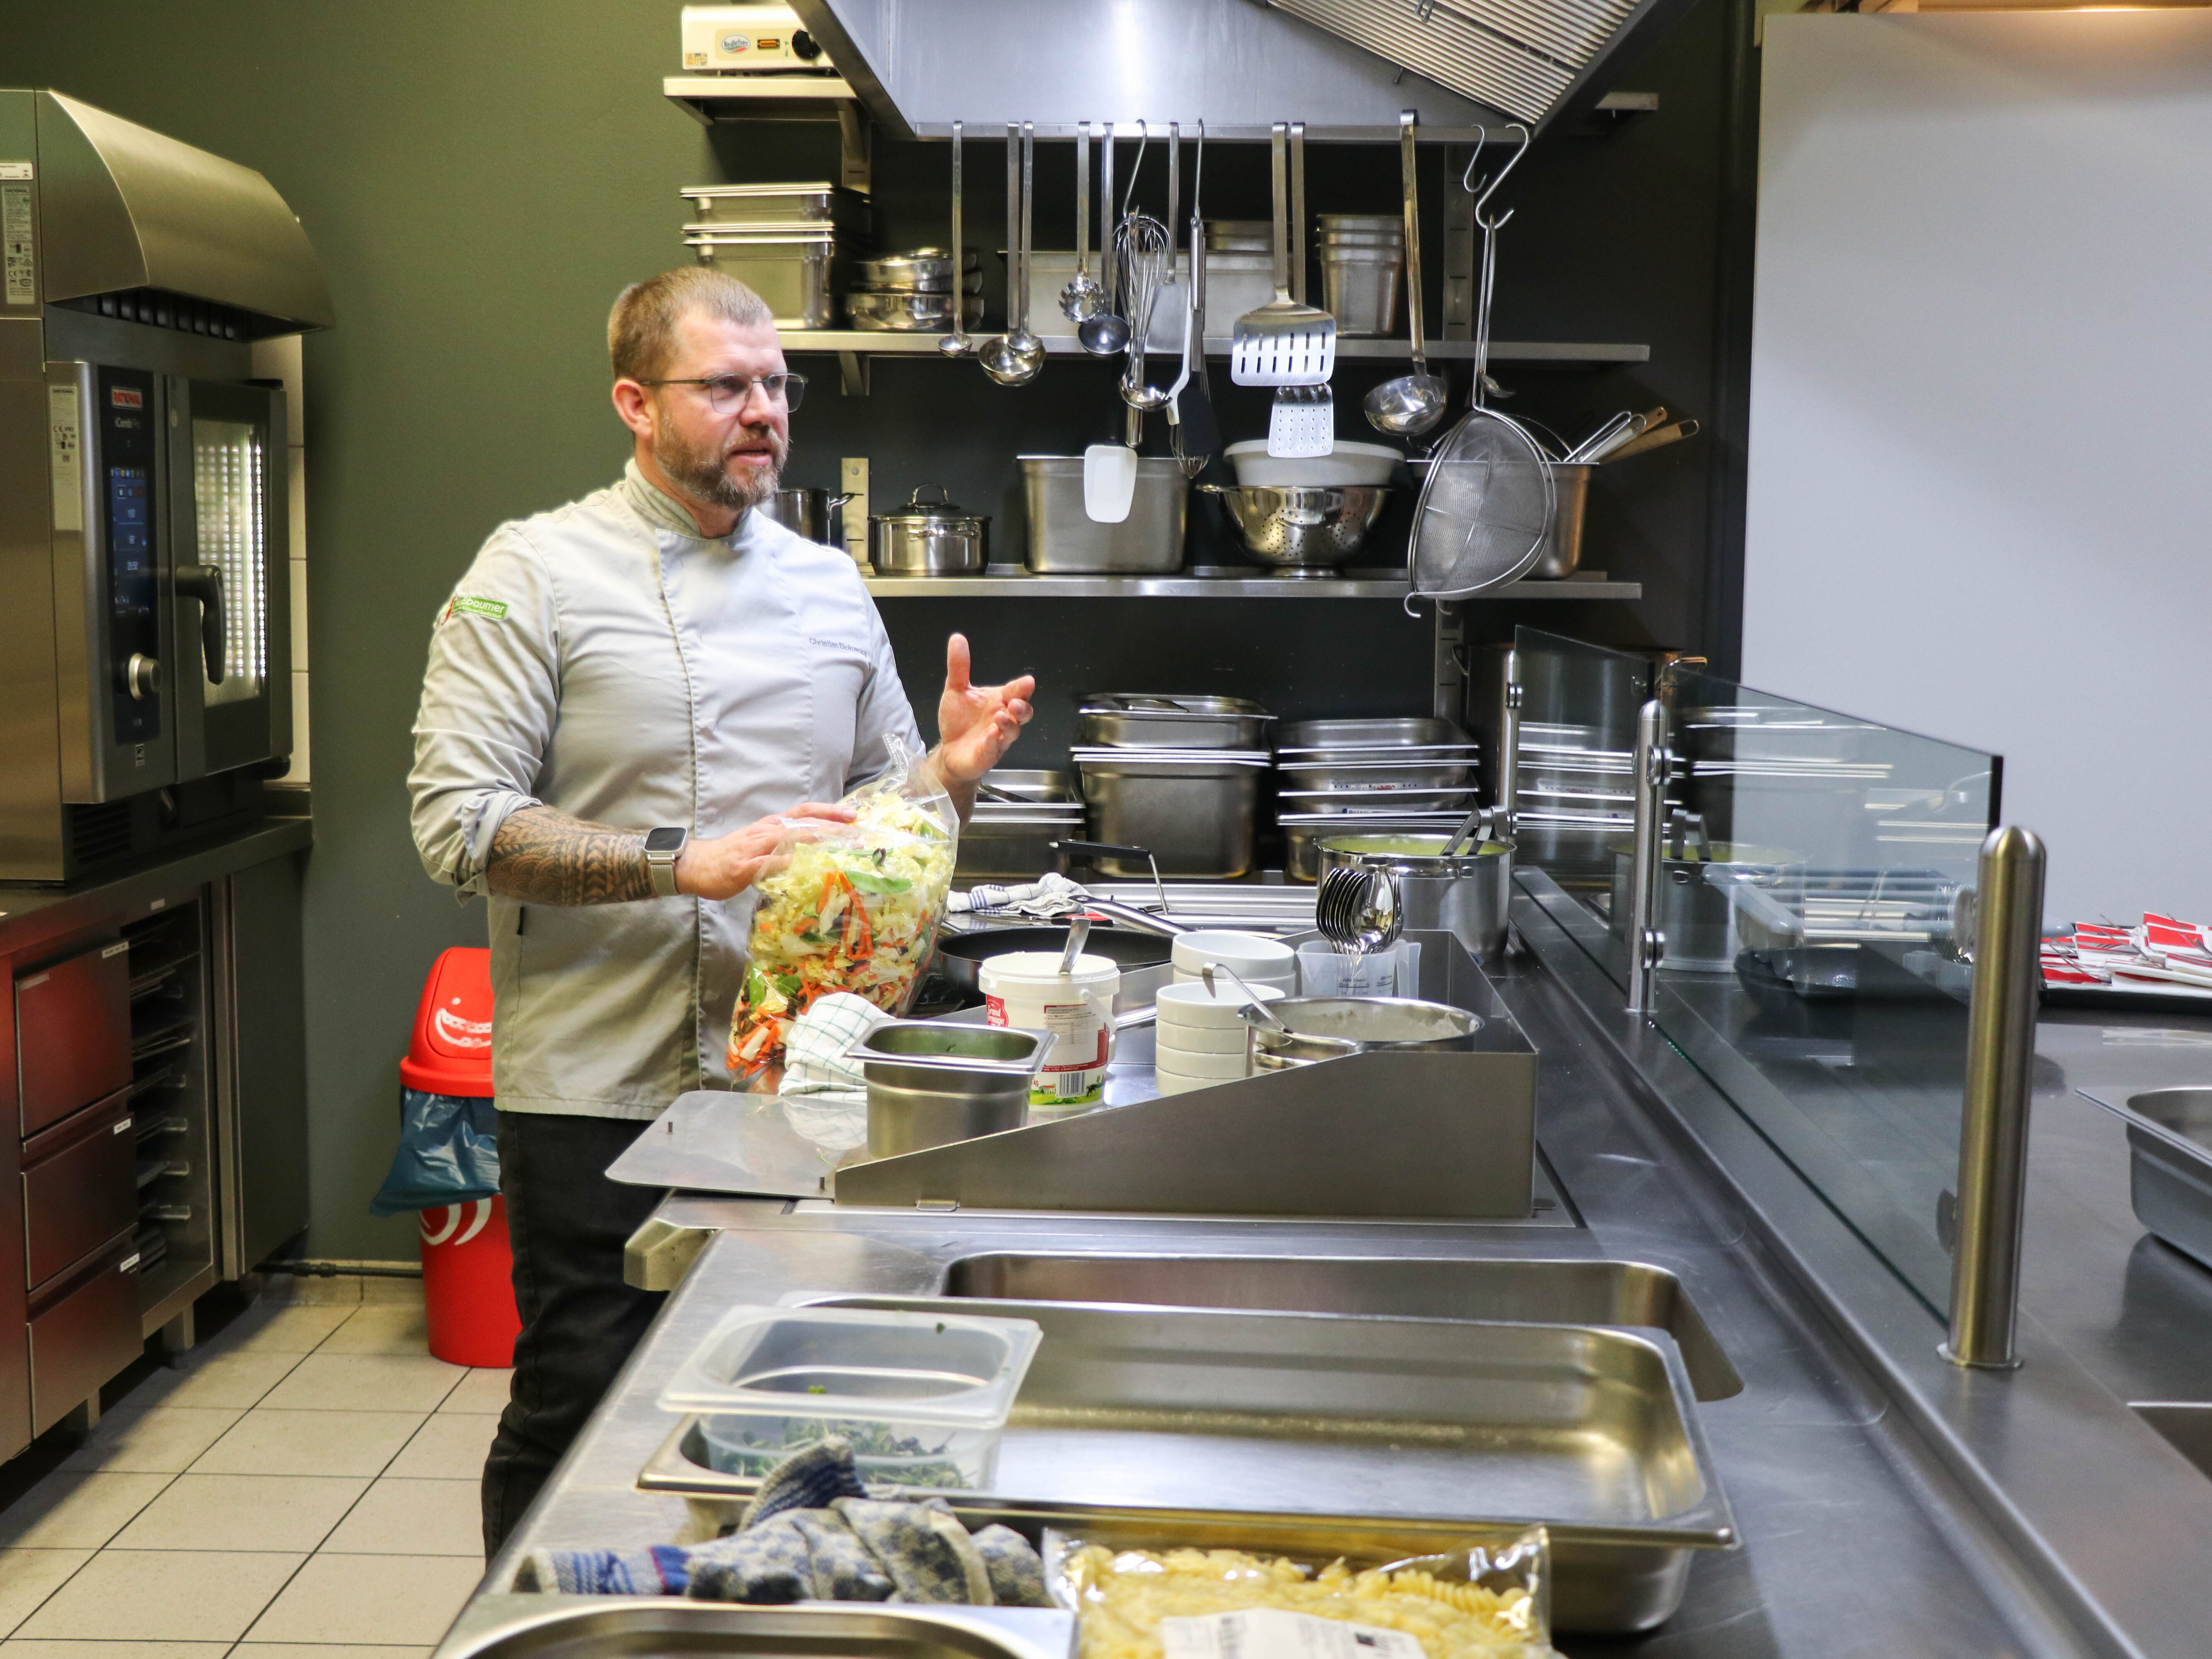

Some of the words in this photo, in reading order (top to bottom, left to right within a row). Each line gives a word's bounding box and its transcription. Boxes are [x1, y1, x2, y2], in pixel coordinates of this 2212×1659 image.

[724, 39, 749, 48] Redlefsen
[114, 392, 141, 405] RATIONAL
[809, 638, 839, 649] Christian
